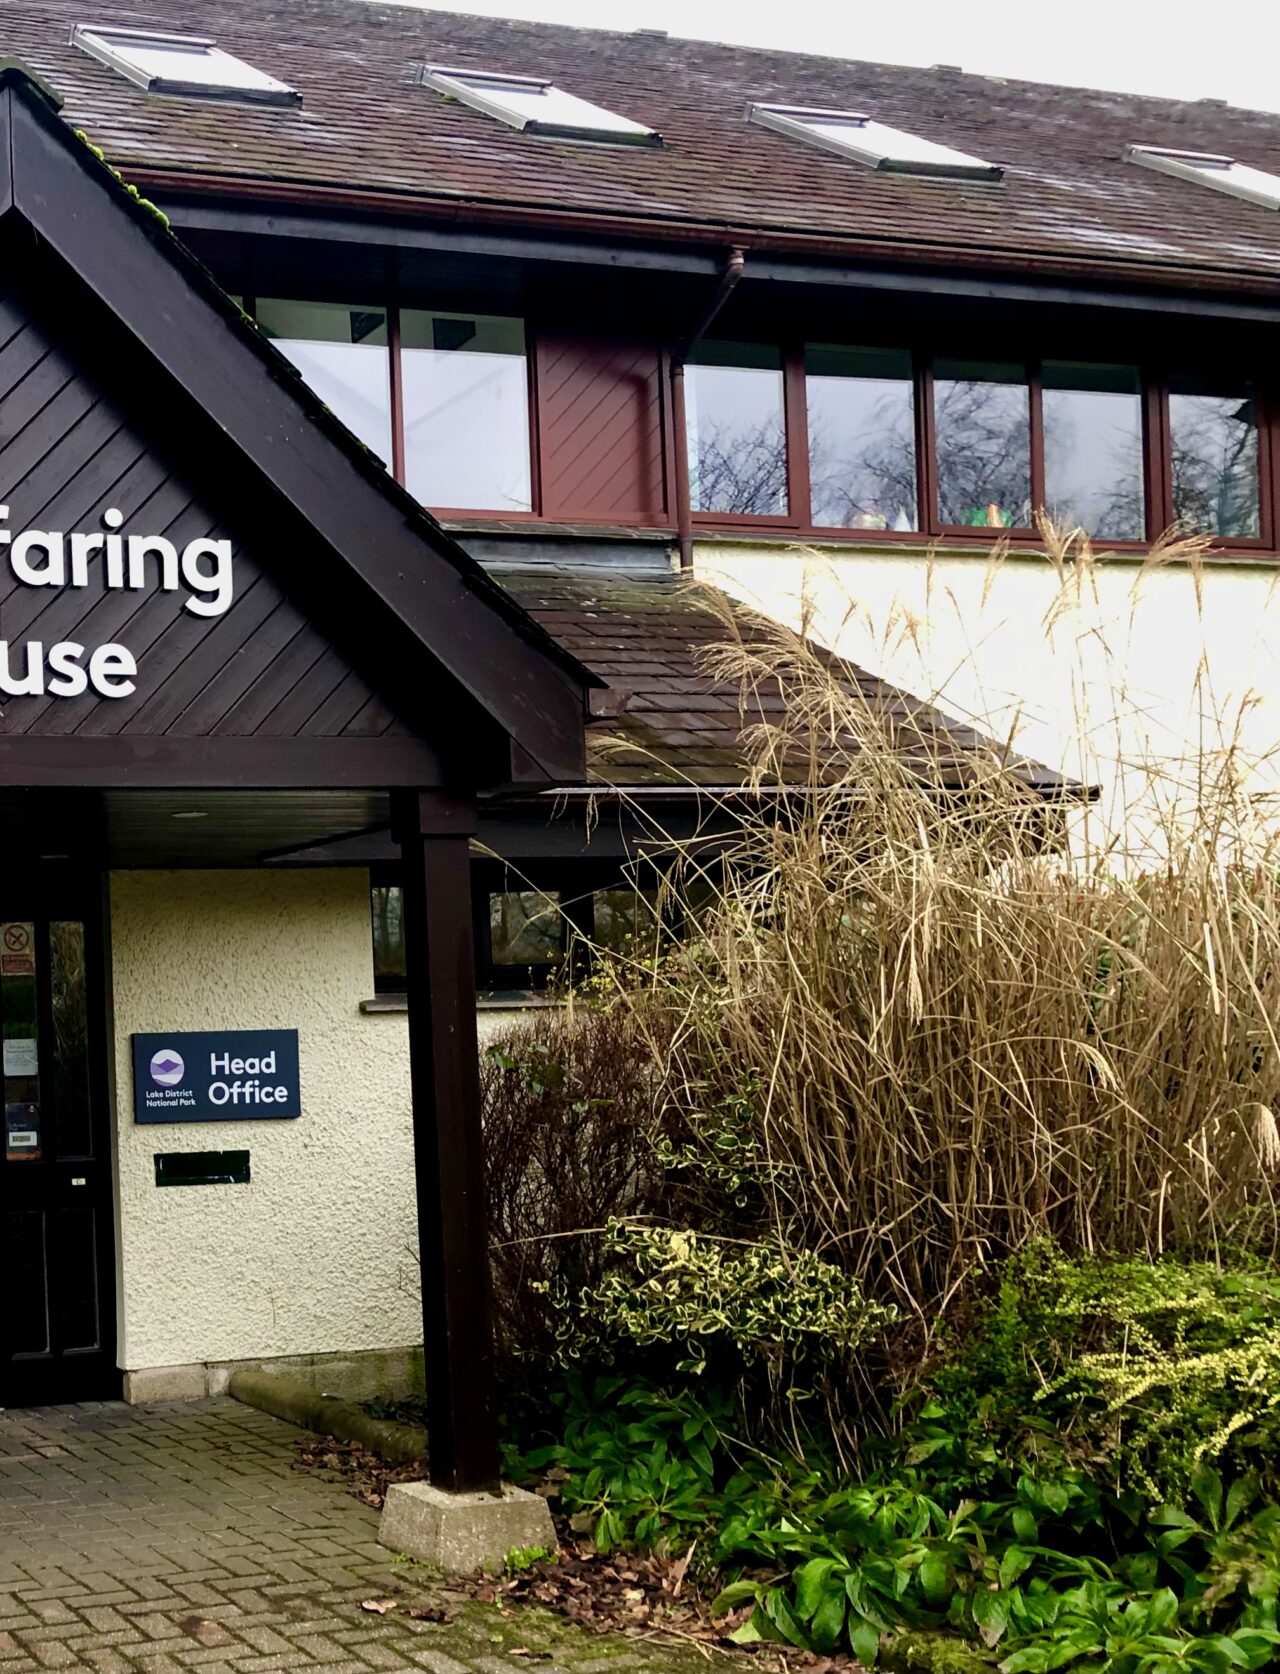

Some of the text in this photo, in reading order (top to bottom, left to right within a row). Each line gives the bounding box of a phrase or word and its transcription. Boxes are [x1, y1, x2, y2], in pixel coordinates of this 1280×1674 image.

[210, 1051, 276, 1075] Head
[146, 1089, 193, 1098] Lake District
[208, 1080, 288, 1105] Office
[146, 1098, 196, 1107] National Park
